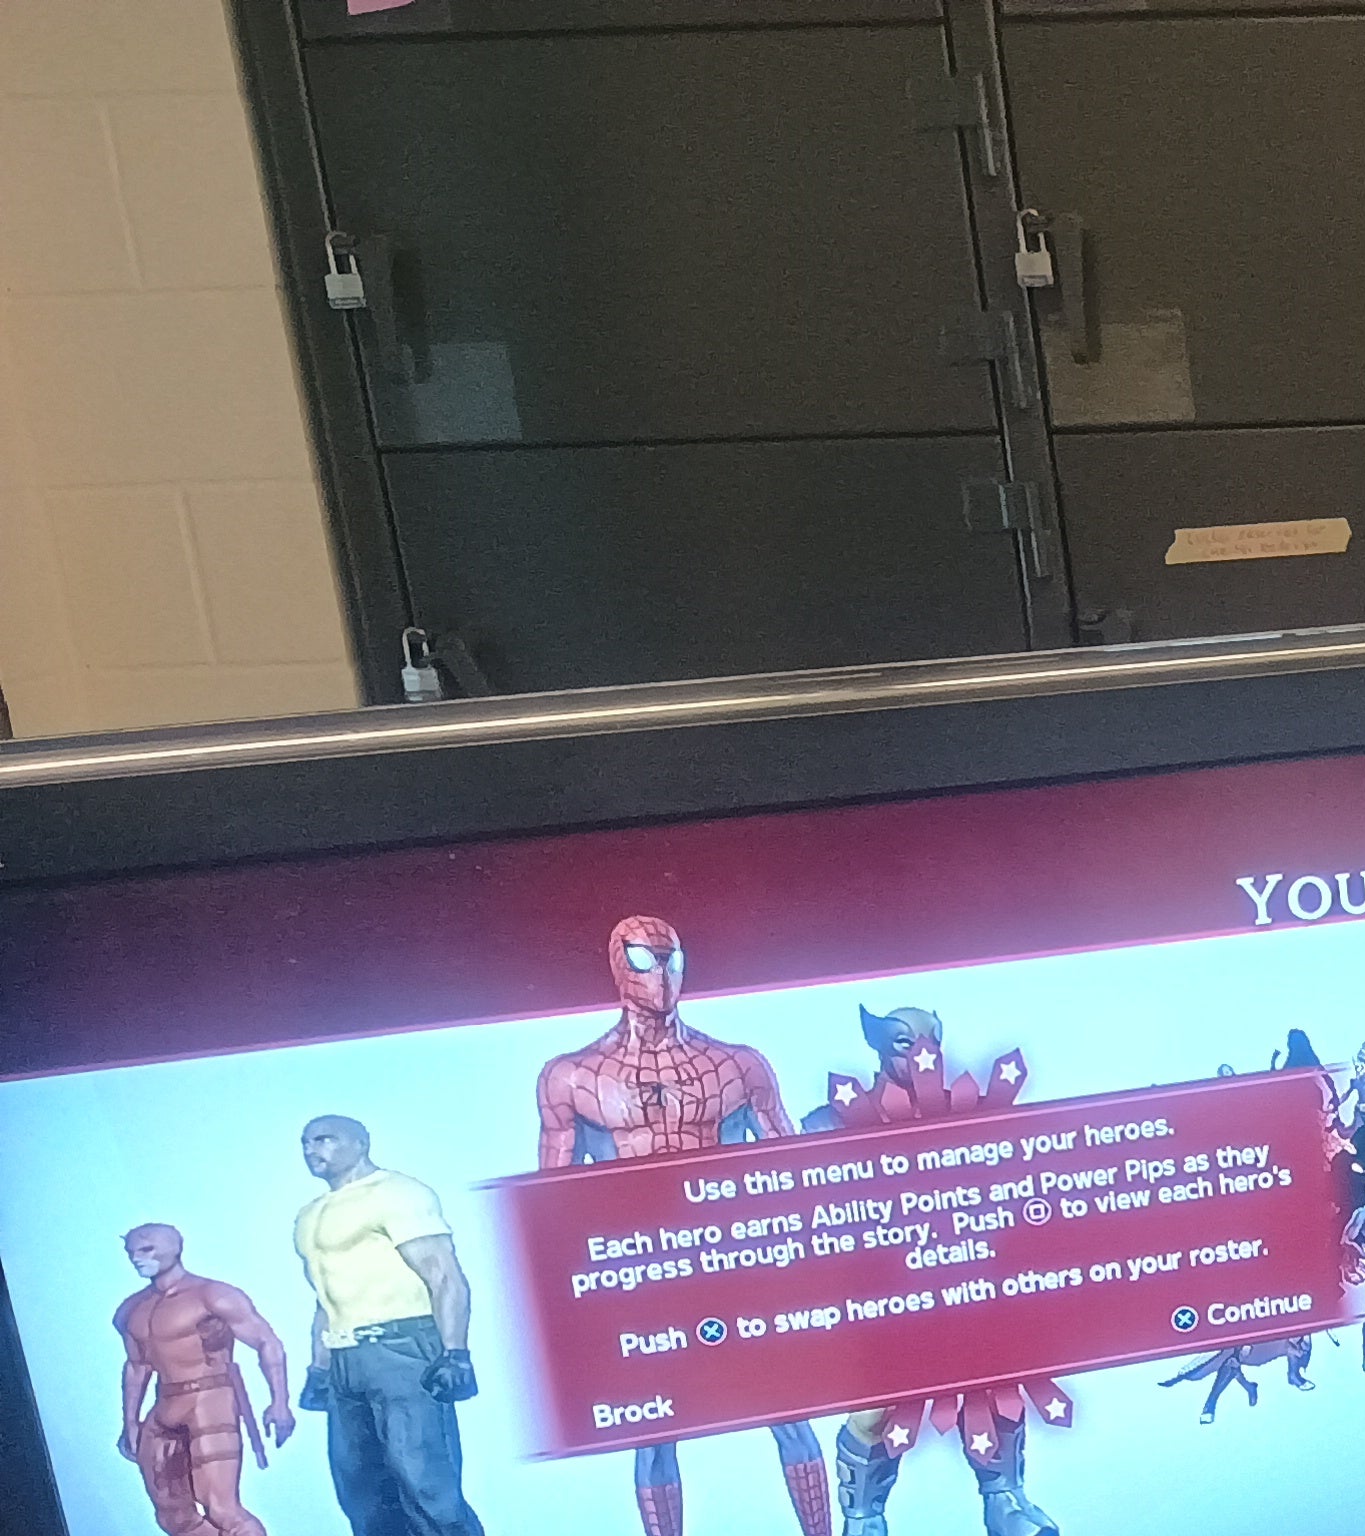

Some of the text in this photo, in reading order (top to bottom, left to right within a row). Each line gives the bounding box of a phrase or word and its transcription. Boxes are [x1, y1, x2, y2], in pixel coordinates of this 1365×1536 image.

[588, 1145, 1270, 1261] Each hero earns Ability Points and Power Pips as they
[684, 1118, 1175, 1203] Use this menu to manage your heroes.
[571, 1165, 1292, 1298] progress through the story. Push to view each hero's
[905, 1238, 996, 1270] details.
[619, 1238, 1269, 1357] Push to swap heroes with others on your roster.
[1207, 1293, 1312, 1326] Continue
[593, 1394, 674, 1429] Brock
